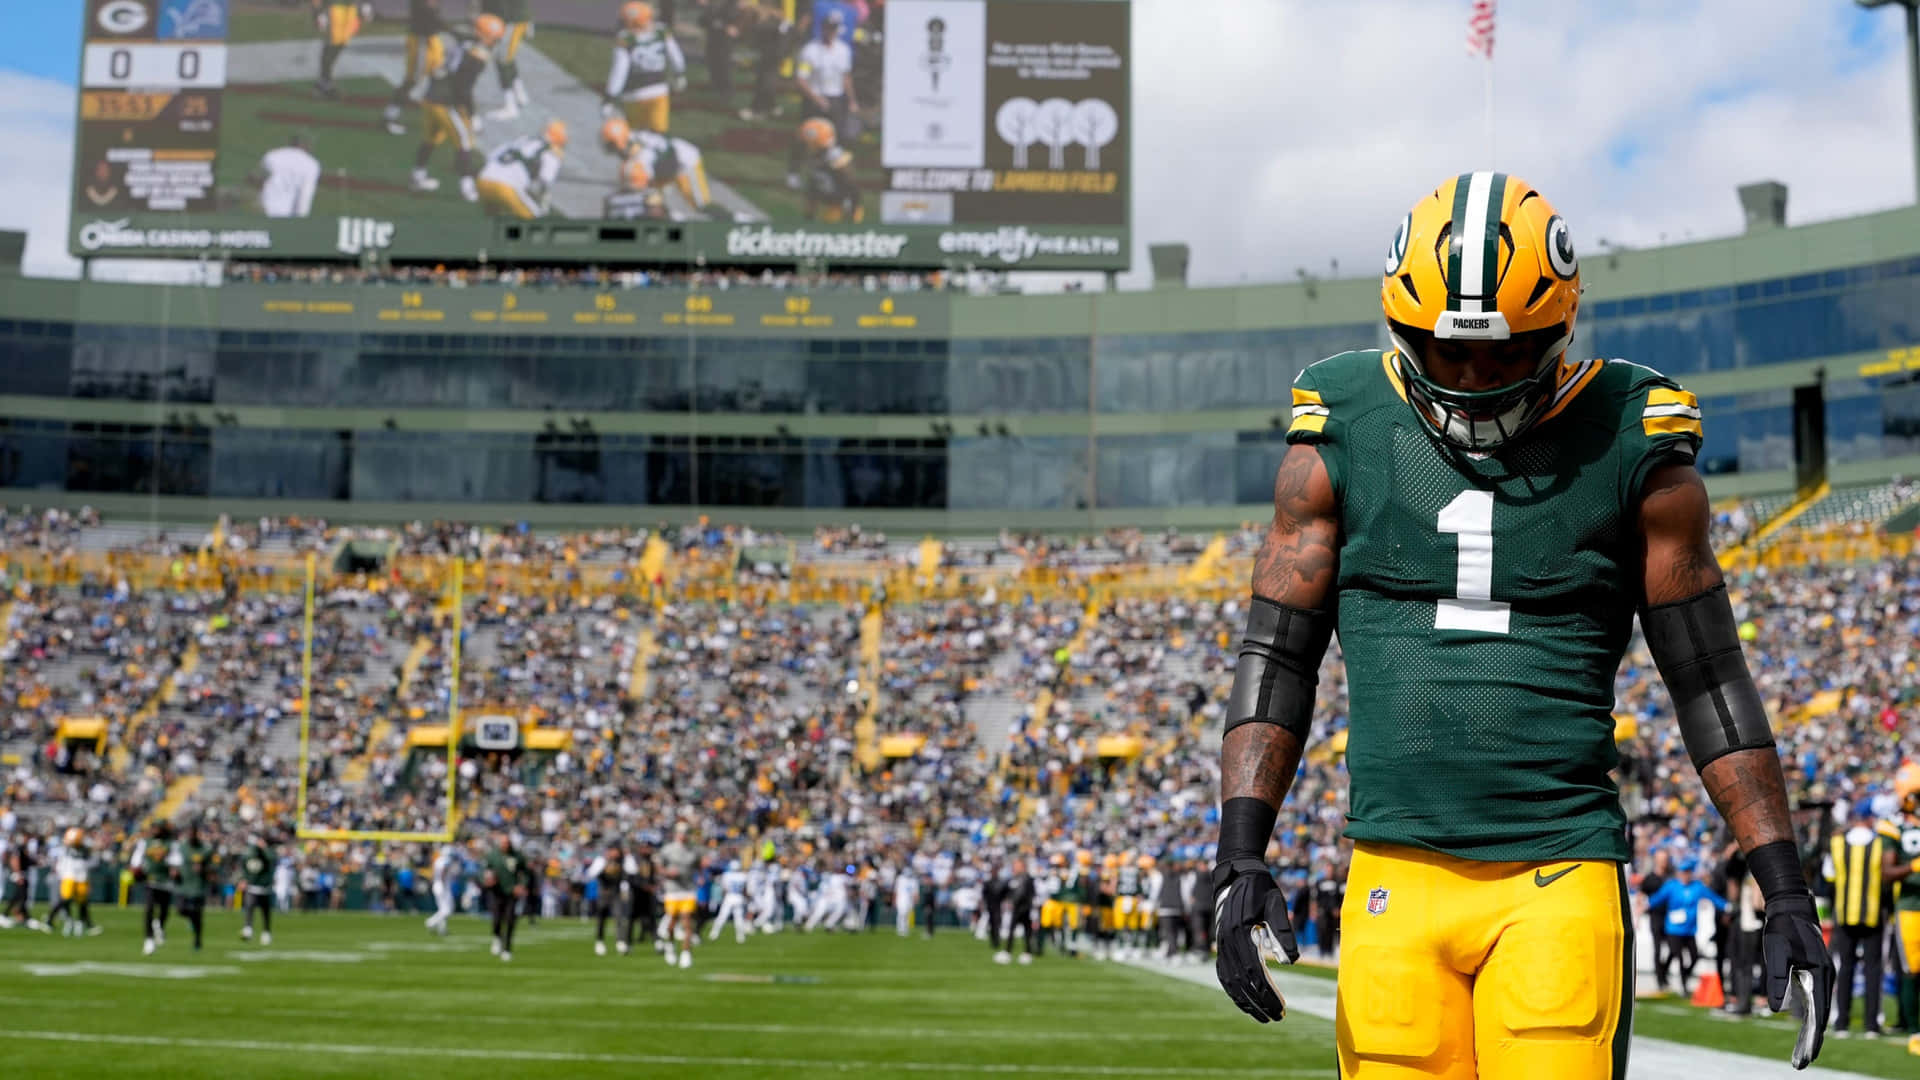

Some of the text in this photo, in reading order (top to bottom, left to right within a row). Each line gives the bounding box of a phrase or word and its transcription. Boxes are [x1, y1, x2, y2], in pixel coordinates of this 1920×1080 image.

[111, 50, 132, 79] 0
[179, 50, 200, 79] 0
[891, 169, 1117, 193] WELCOME TO LAMBEAU FIELD
[338, 217, 394, 254] Lite
[728, 225, 908, 257] ticketmaster
[1453, 318, 1490, 329] PACKERS
[1433, 489, 1512, 635] 1
